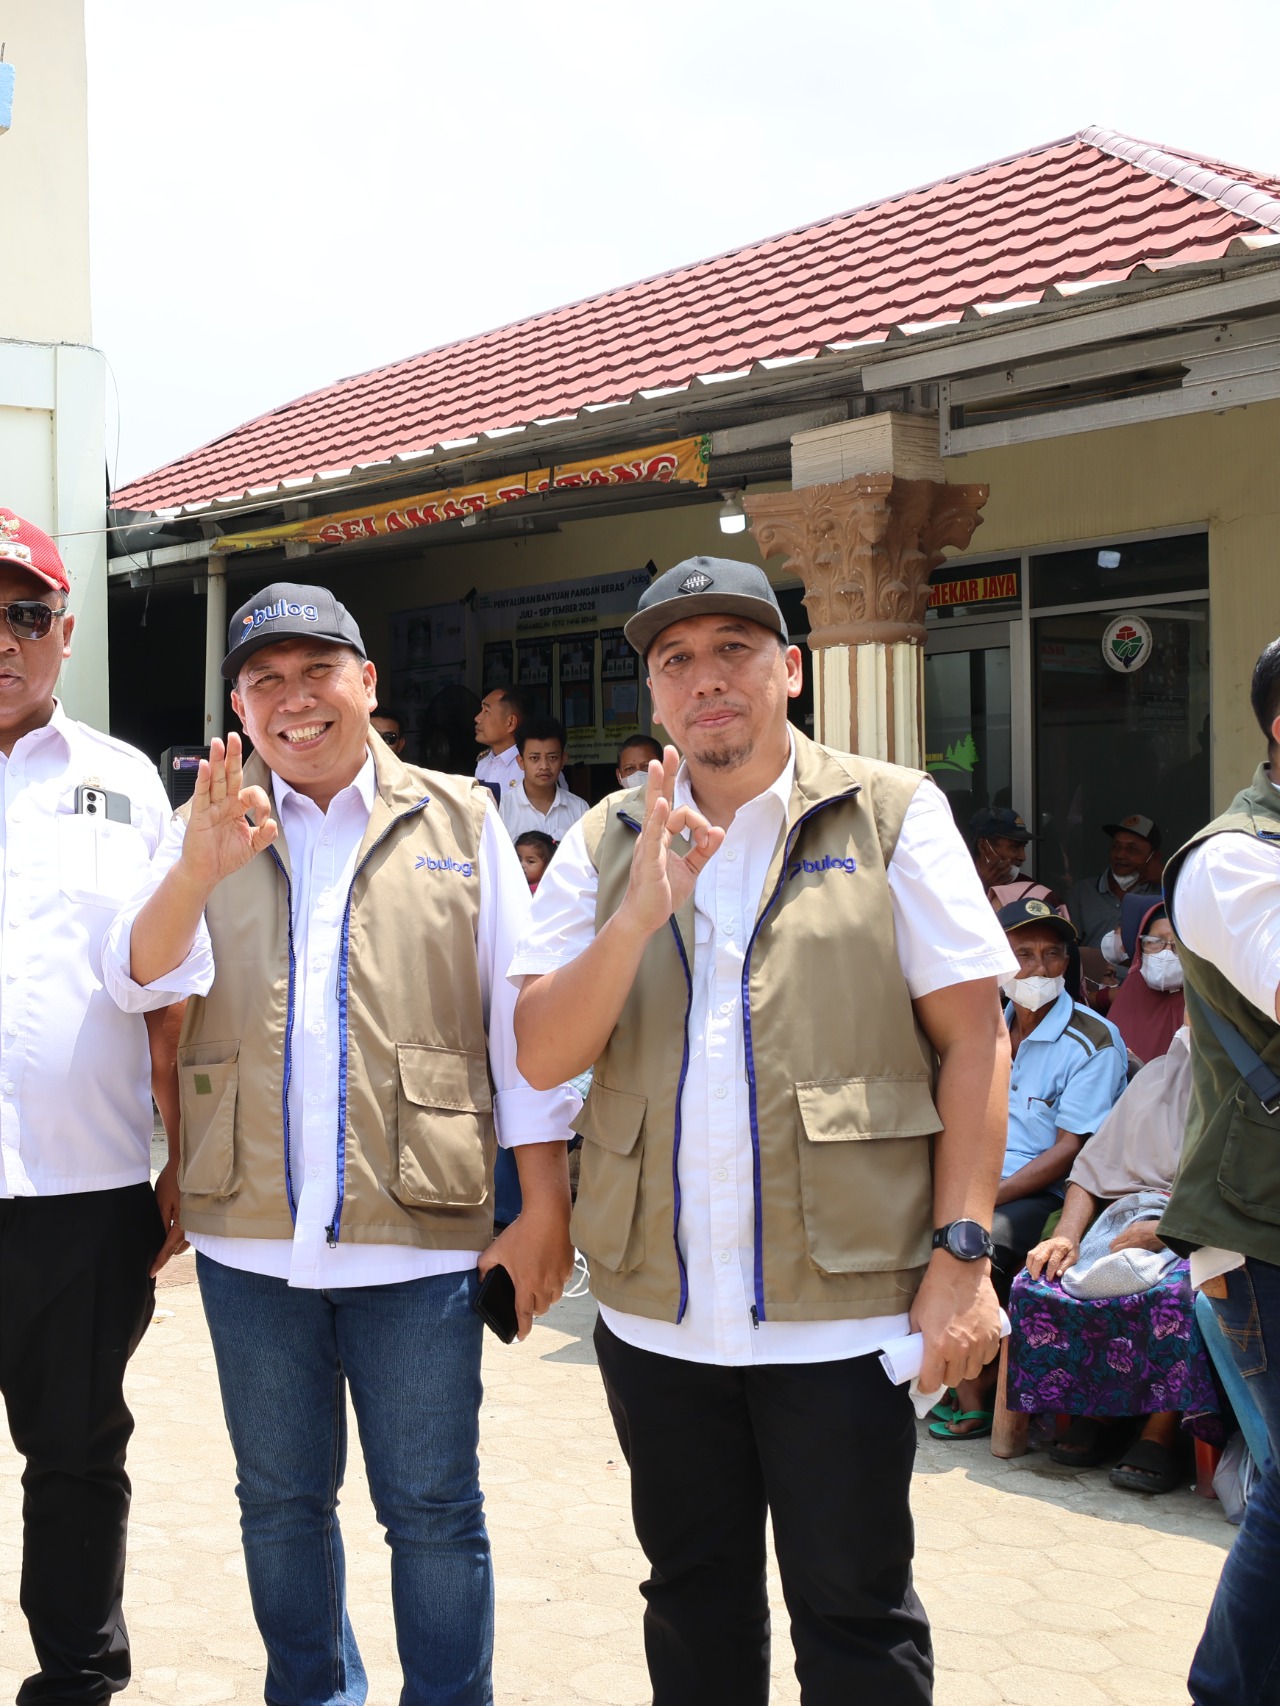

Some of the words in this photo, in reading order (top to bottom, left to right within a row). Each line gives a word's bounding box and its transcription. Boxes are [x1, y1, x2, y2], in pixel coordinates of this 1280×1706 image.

[493, 595, 535, 608] PENYALURAN
[536, 590, 569, 603] BANTUAN
[570, 585, 600, 598] PANGAN
[601, 582, 625, 594] BERAS
[928, 578, 978, 606] MEKAR
[982, 574, 1015, 598] JAYA
[253, 599, 319, 627] bulog
[519, 608, 533, 619] JULI
[539, 603, 577, 617] SEPTEMBER
[578, 601, 596, 612] 2026
[426, 856, 473, 877] bulog
[802, 854, 856, 873] bulog
